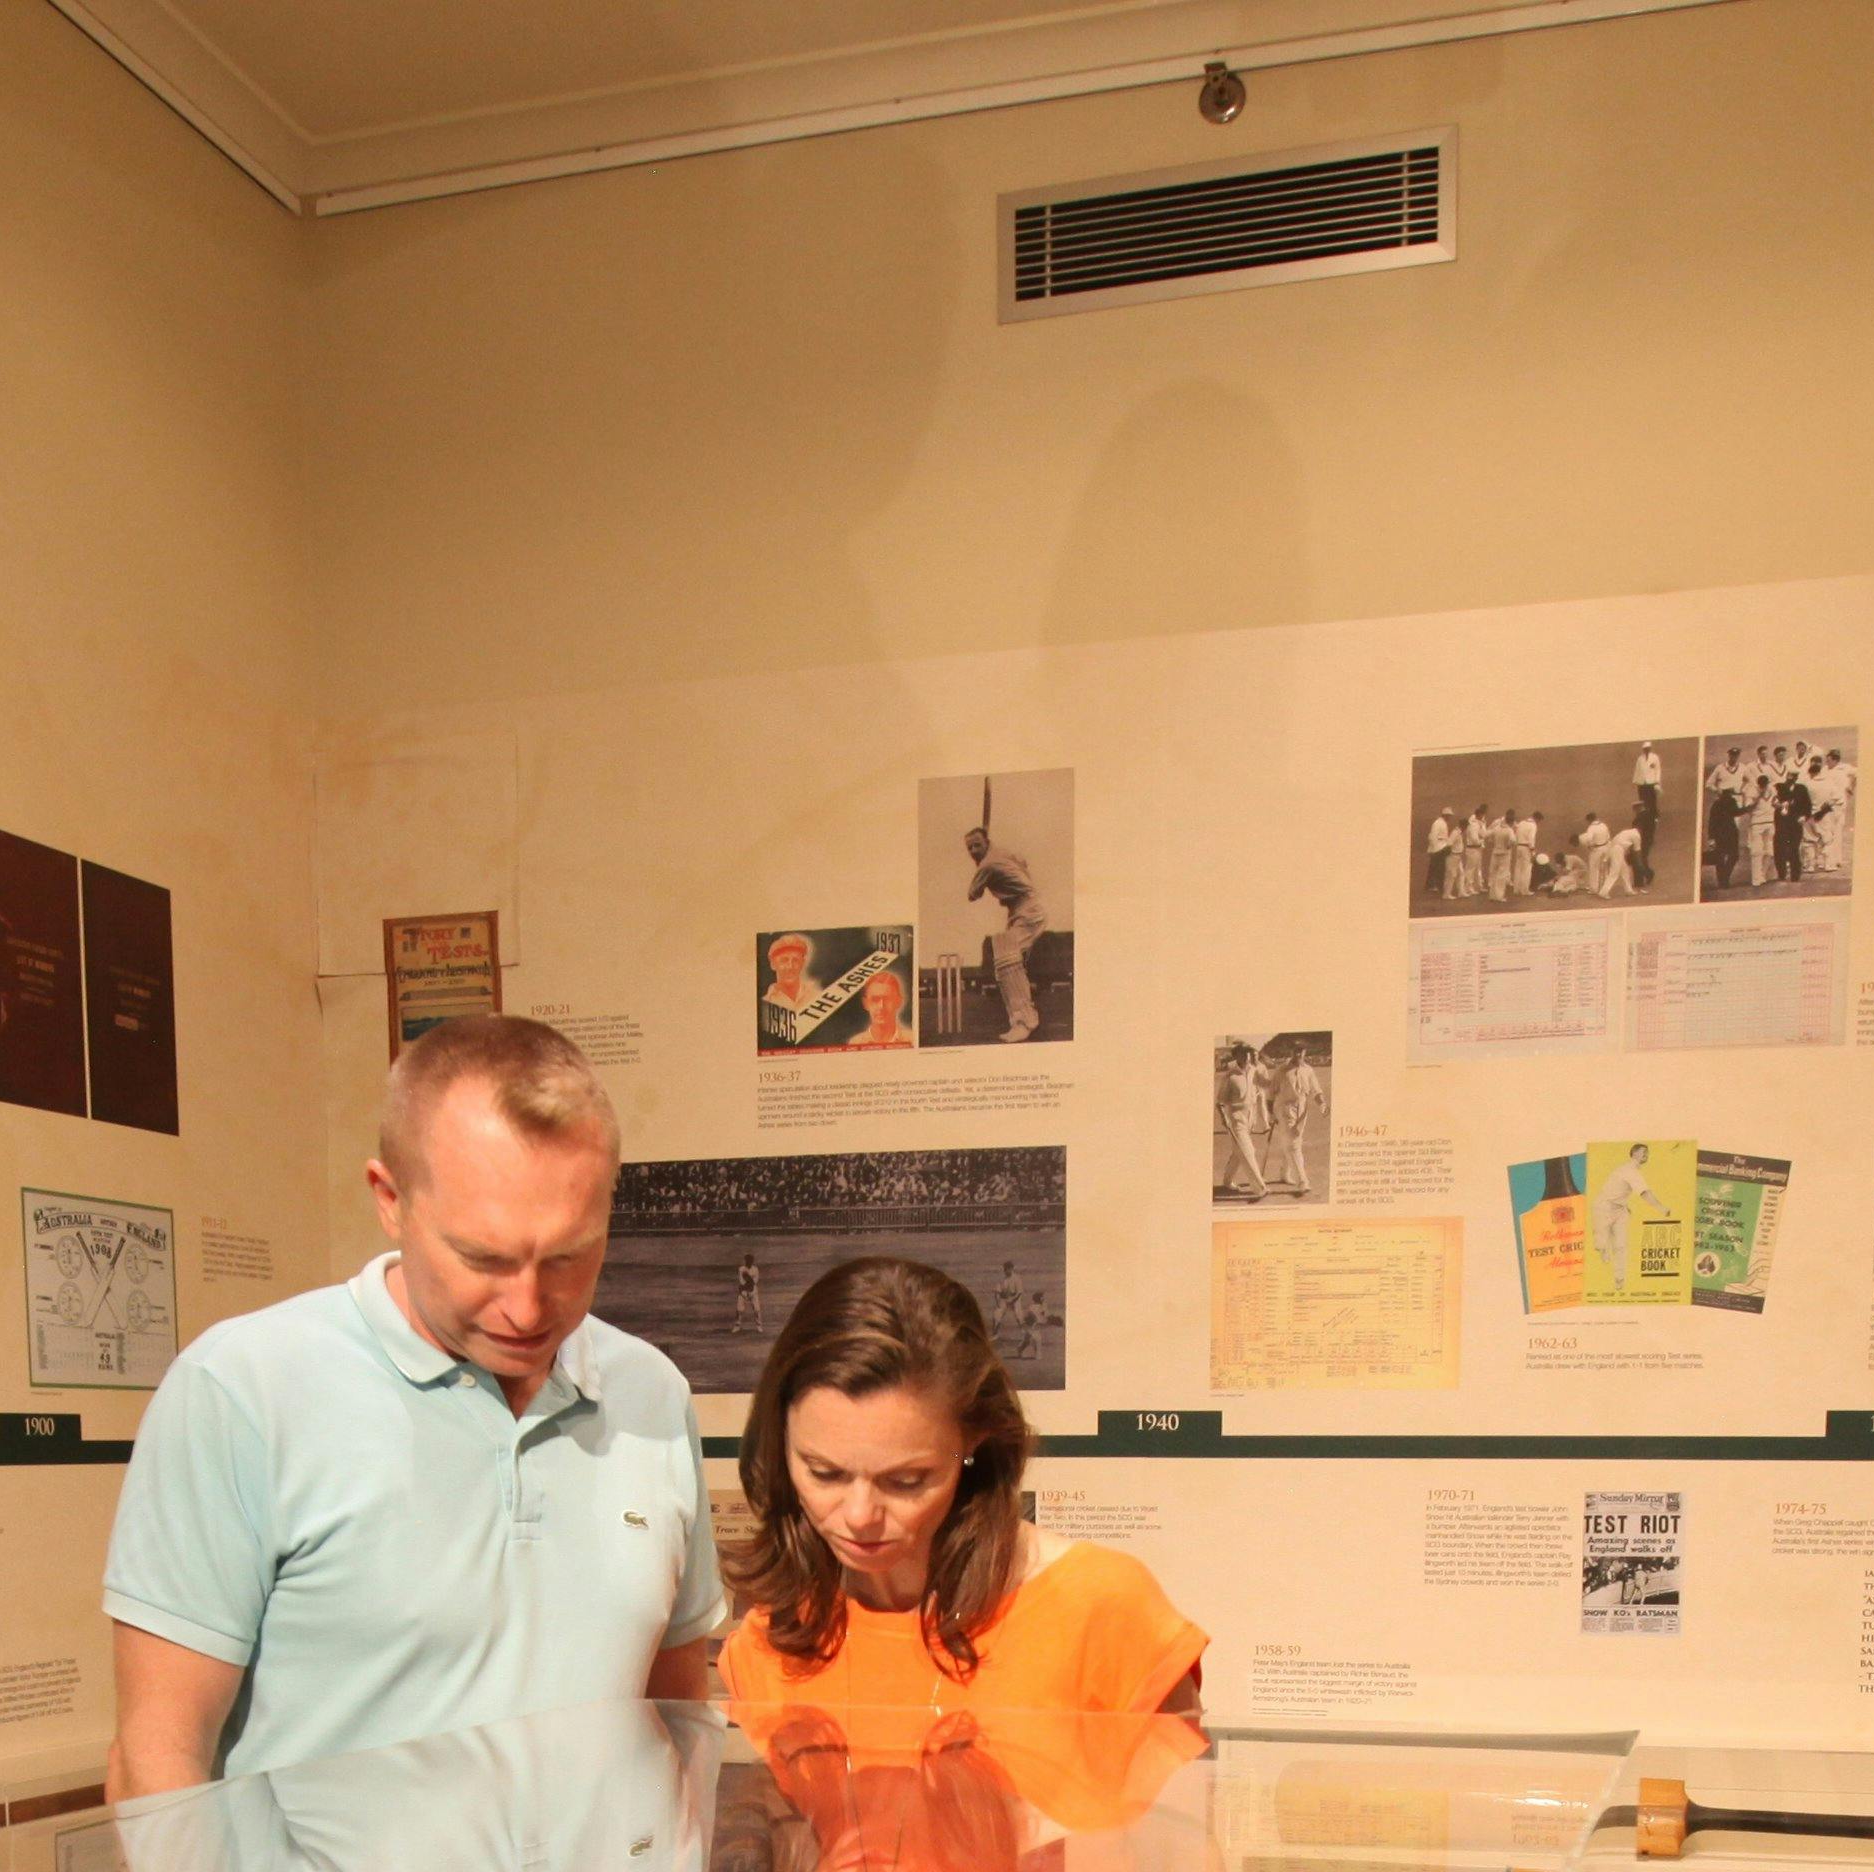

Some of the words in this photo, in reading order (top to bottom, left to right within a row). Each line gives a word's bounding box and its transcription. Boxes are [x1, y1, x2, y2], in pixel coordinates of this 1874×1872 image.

[876, 932, 900, 953] 1937
[799, 989, 842, 1021] THE
[844, 955, 888, 993] ASHES
[530, 1005, 571, 1015] 1920-21
[767, 1004, 797, 1043] 1936
[758, 1071, 801, 1083] 1936-37
[1339, 1125, 1387, 1137] 1946-47
[1529, 1246, 1554, 1258] TEST
[1641, 1248, 1681, 1259] CRICKET
[1641, 1260, 1667, 1272] BOOK
[1527, 1337, 1577, 1349] 1962-63
[26, 1418, 55, 1435] 1900
[1135, 1412, 1180, 1431] 1940
[1041, 1490, 1086, 1501] 1939-45
[1428, 1489, 1475, 1500] 1970-71
[1600, 1493, 1633, 1505] Sunday
[1776, 1503, 1827, 1514] 1974-75
[1584, 1515, 1627, 1534] TEST
[1641, 1515, 1681, 1534] RIOT
[1587, 1537, 1628, 1547] Amazing
[1589, 1545, 1626, 1555] England
[1636, 1609, 1678, 1617] BATSMAN
[1255, 1645, 1301, 1655] 1958-59
